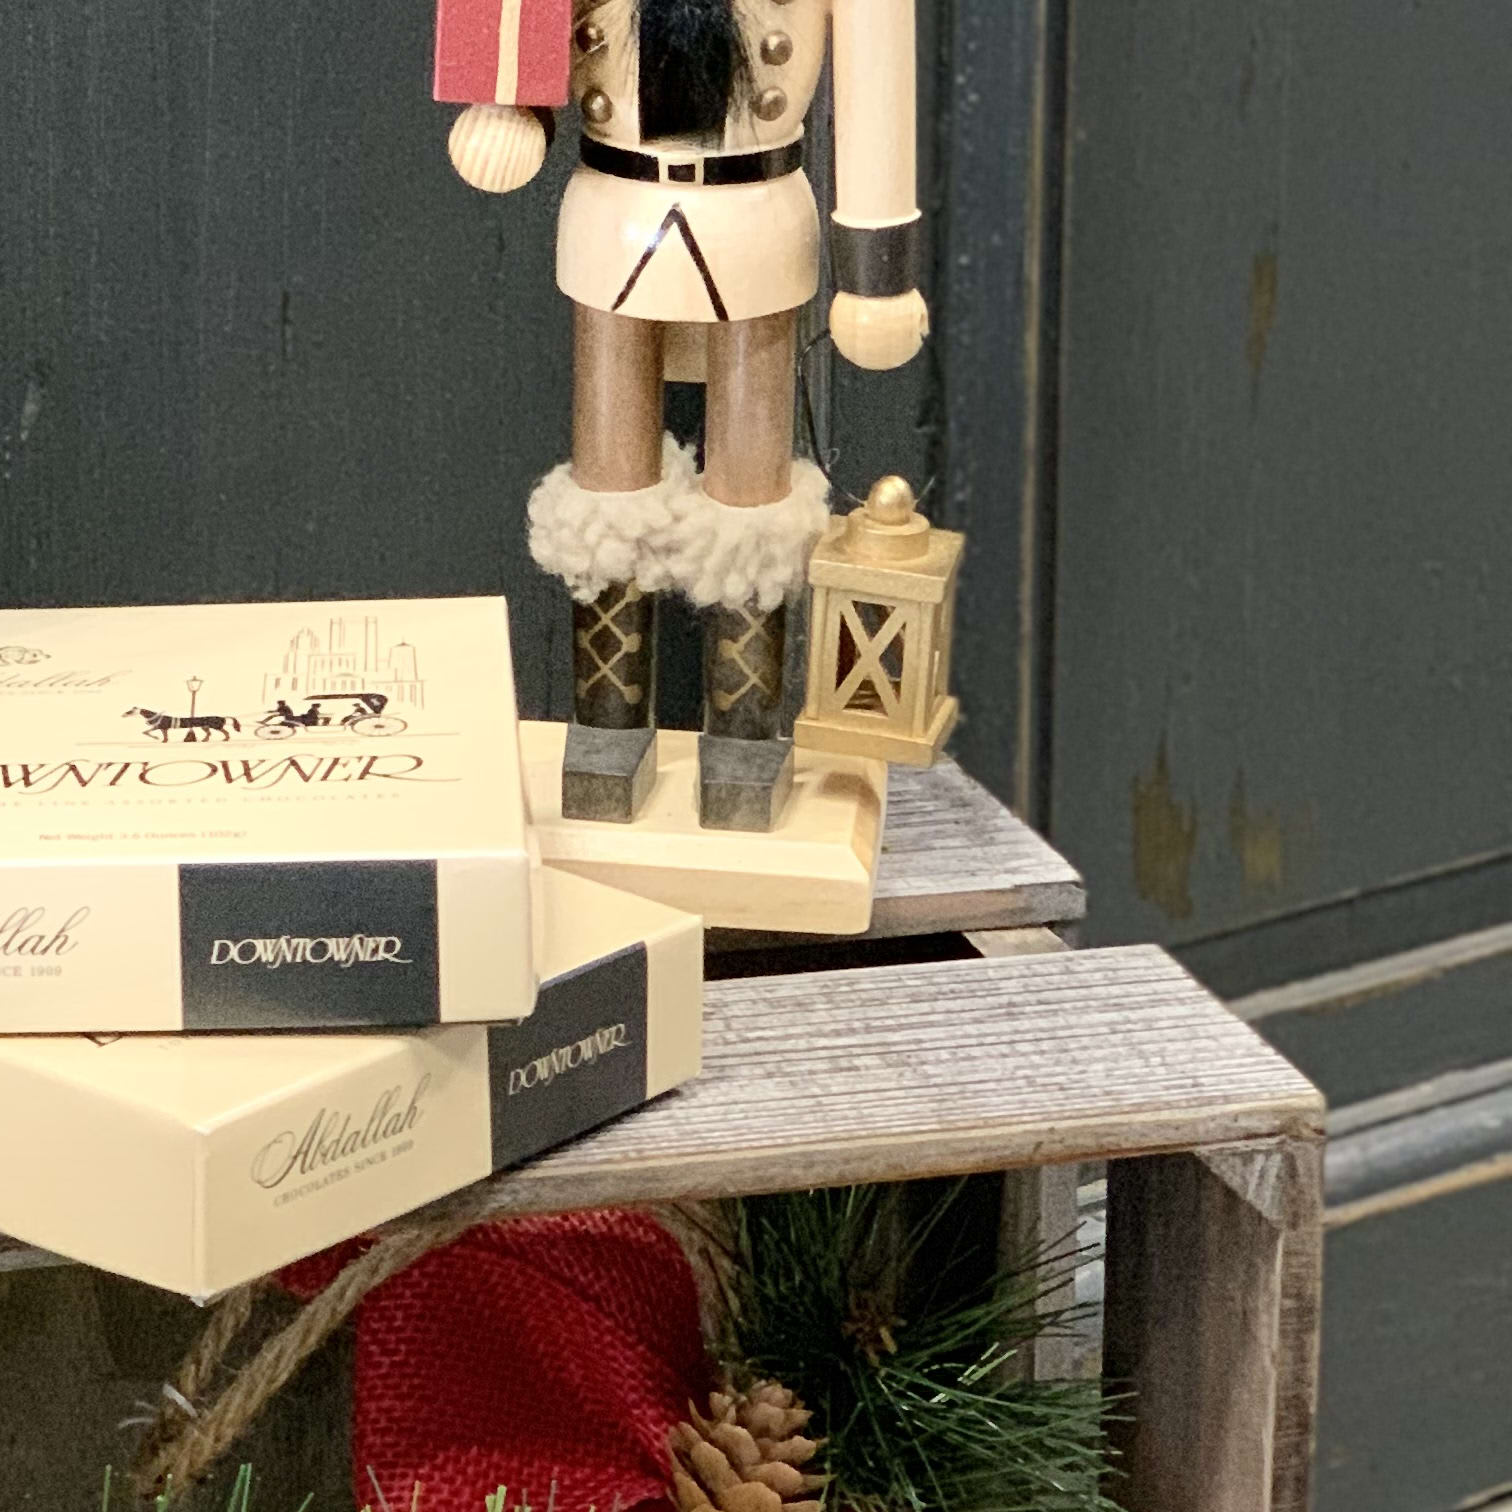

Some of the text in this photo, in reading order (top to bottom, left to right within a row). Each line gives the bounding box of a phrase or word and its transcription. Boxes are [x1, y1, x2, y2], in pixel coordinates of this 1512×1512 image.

[210, 933, 413, 969] DOWNTOWNER
[508, 1023, 633, 1096] DOWNTOWNER
[250, 1071, 433, 1189] Abdallah
